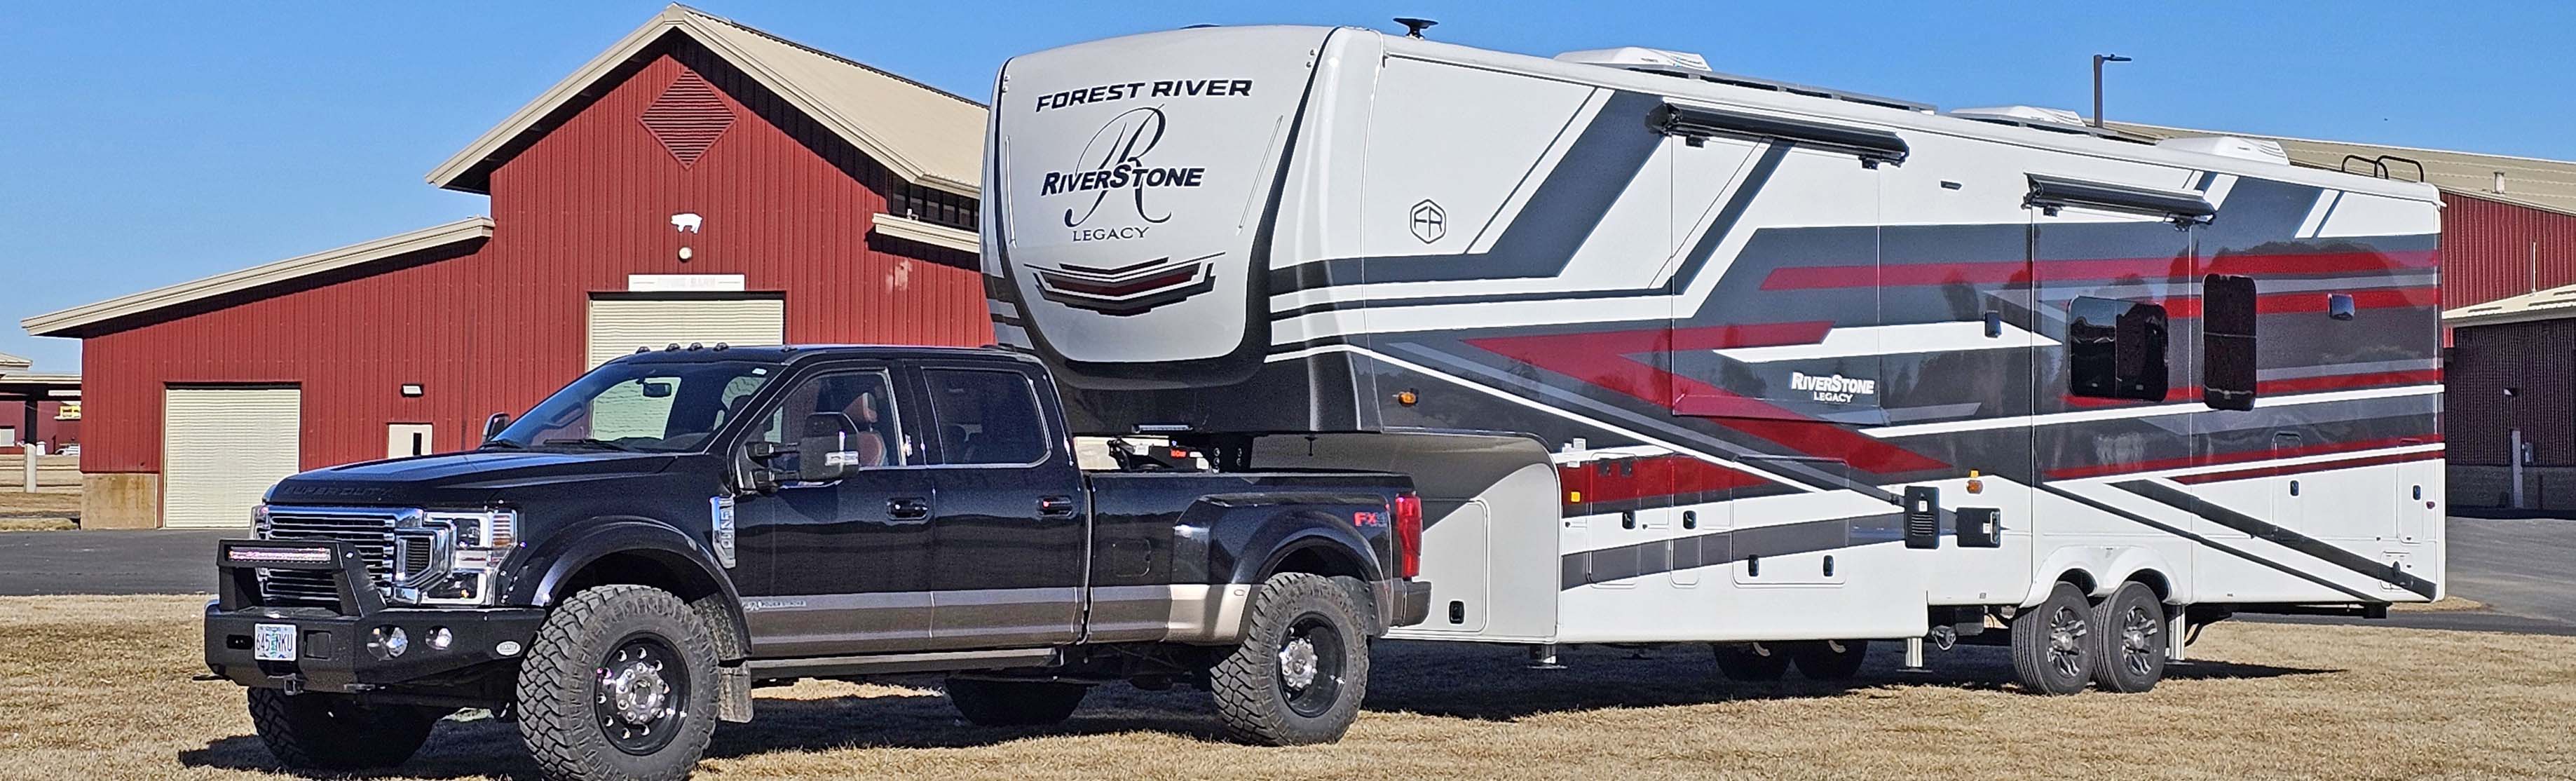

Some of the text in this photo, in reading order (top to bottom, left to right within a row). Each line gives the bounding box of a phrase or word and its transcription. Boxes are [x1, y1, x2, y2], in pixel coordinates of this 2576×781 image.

[1035, 79, 1253, 112] FOREST RIVER
[1072, 226, 1150, 241] LEGACY
[1813, 391, 1853, 403] LEGACY
[275, 633, 293, 652] NKU
